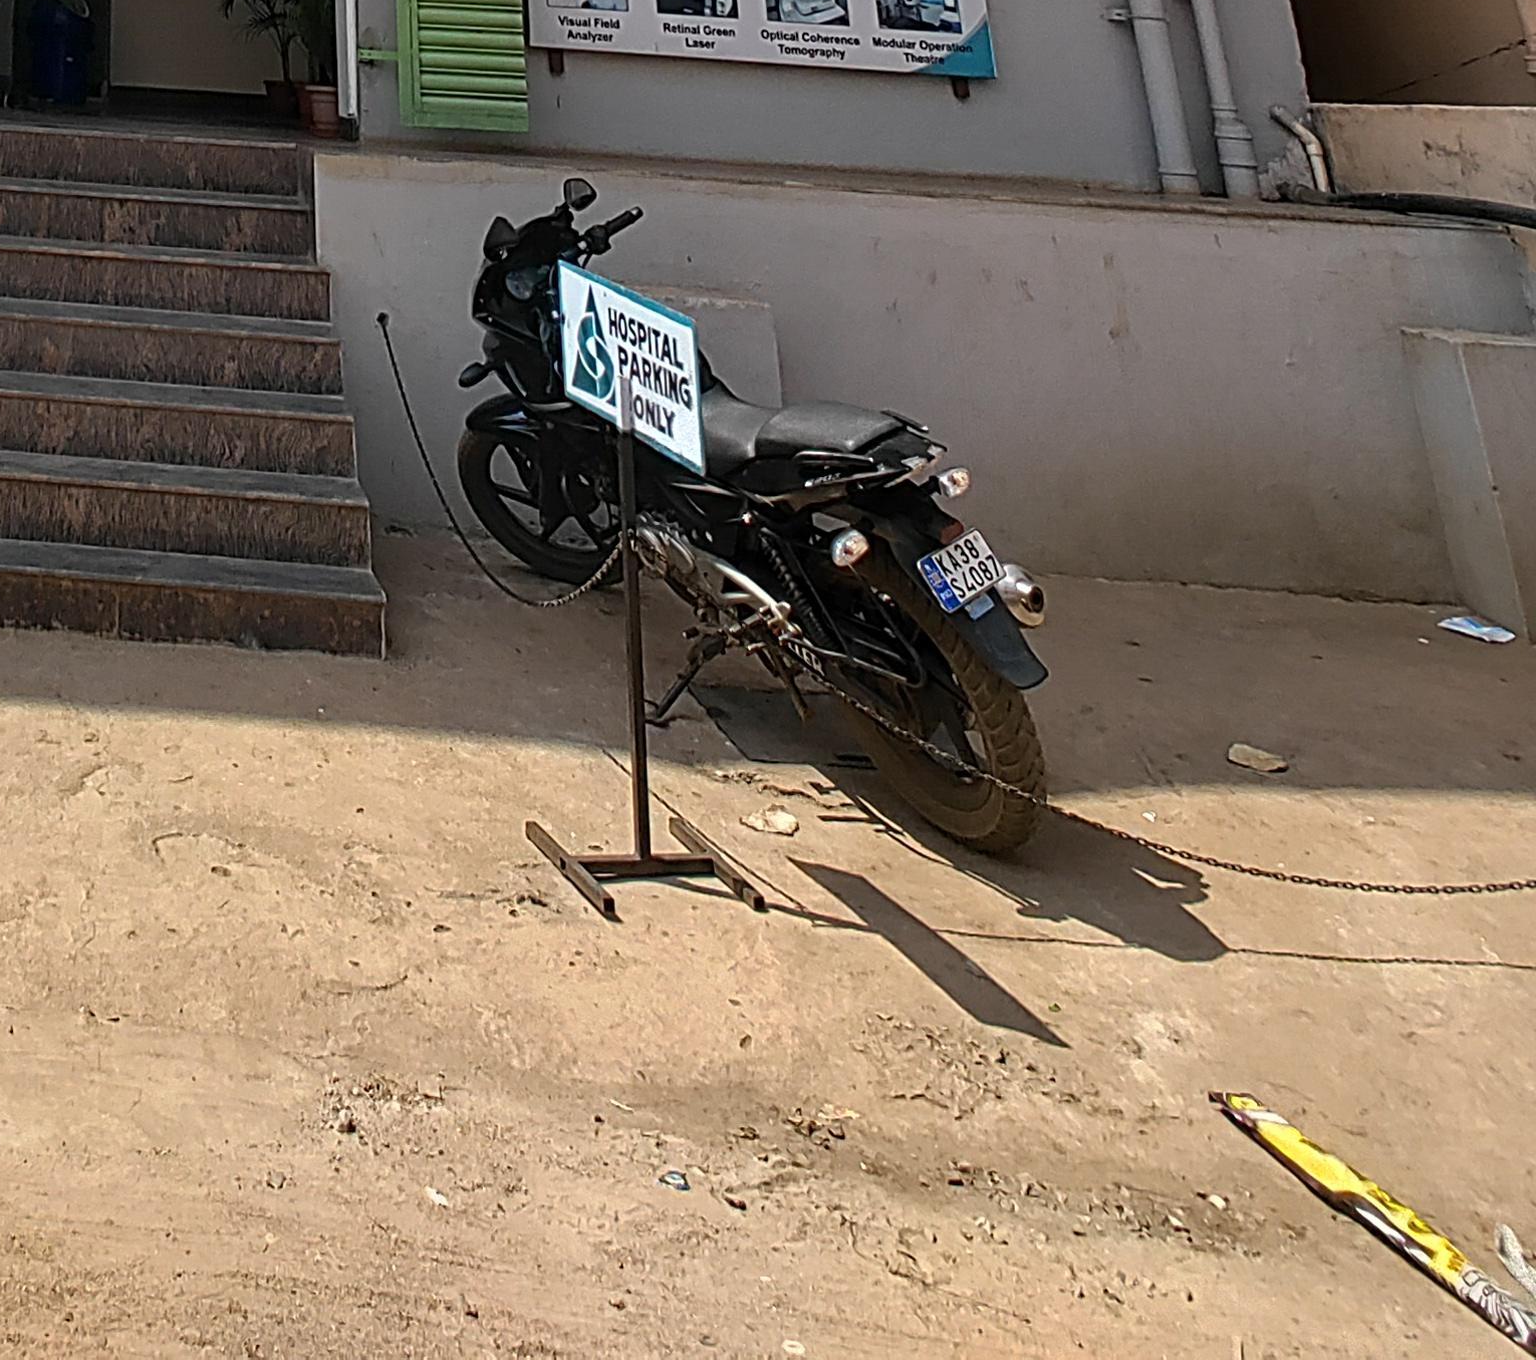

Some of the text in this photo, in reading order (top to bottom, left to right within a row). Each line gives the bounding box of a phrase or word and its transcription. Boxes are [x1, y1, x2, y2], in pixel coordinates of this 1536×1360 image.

[558, 16, 620, 29] Visual Field
[663, 22, 736, 37] Retinal Green
[567, 30, 613, 43] Analyzer
[685, 37, 716, 49] Laser
[761, 29, 861, 46] Optical Coherence
[872, 36, 973, 53] Modular Operation
[777, 44, 846, 60] Tomography
[903, 53, 945, 65] Theatre
[607, 307, 684, 371] HOSPITAL
[617, 345, 692, 411] PARKING
[633, 393, 675, 439] ONLY
[935, 538, 980, 576] KA38
[950, 555, 1000, 599] S4087
